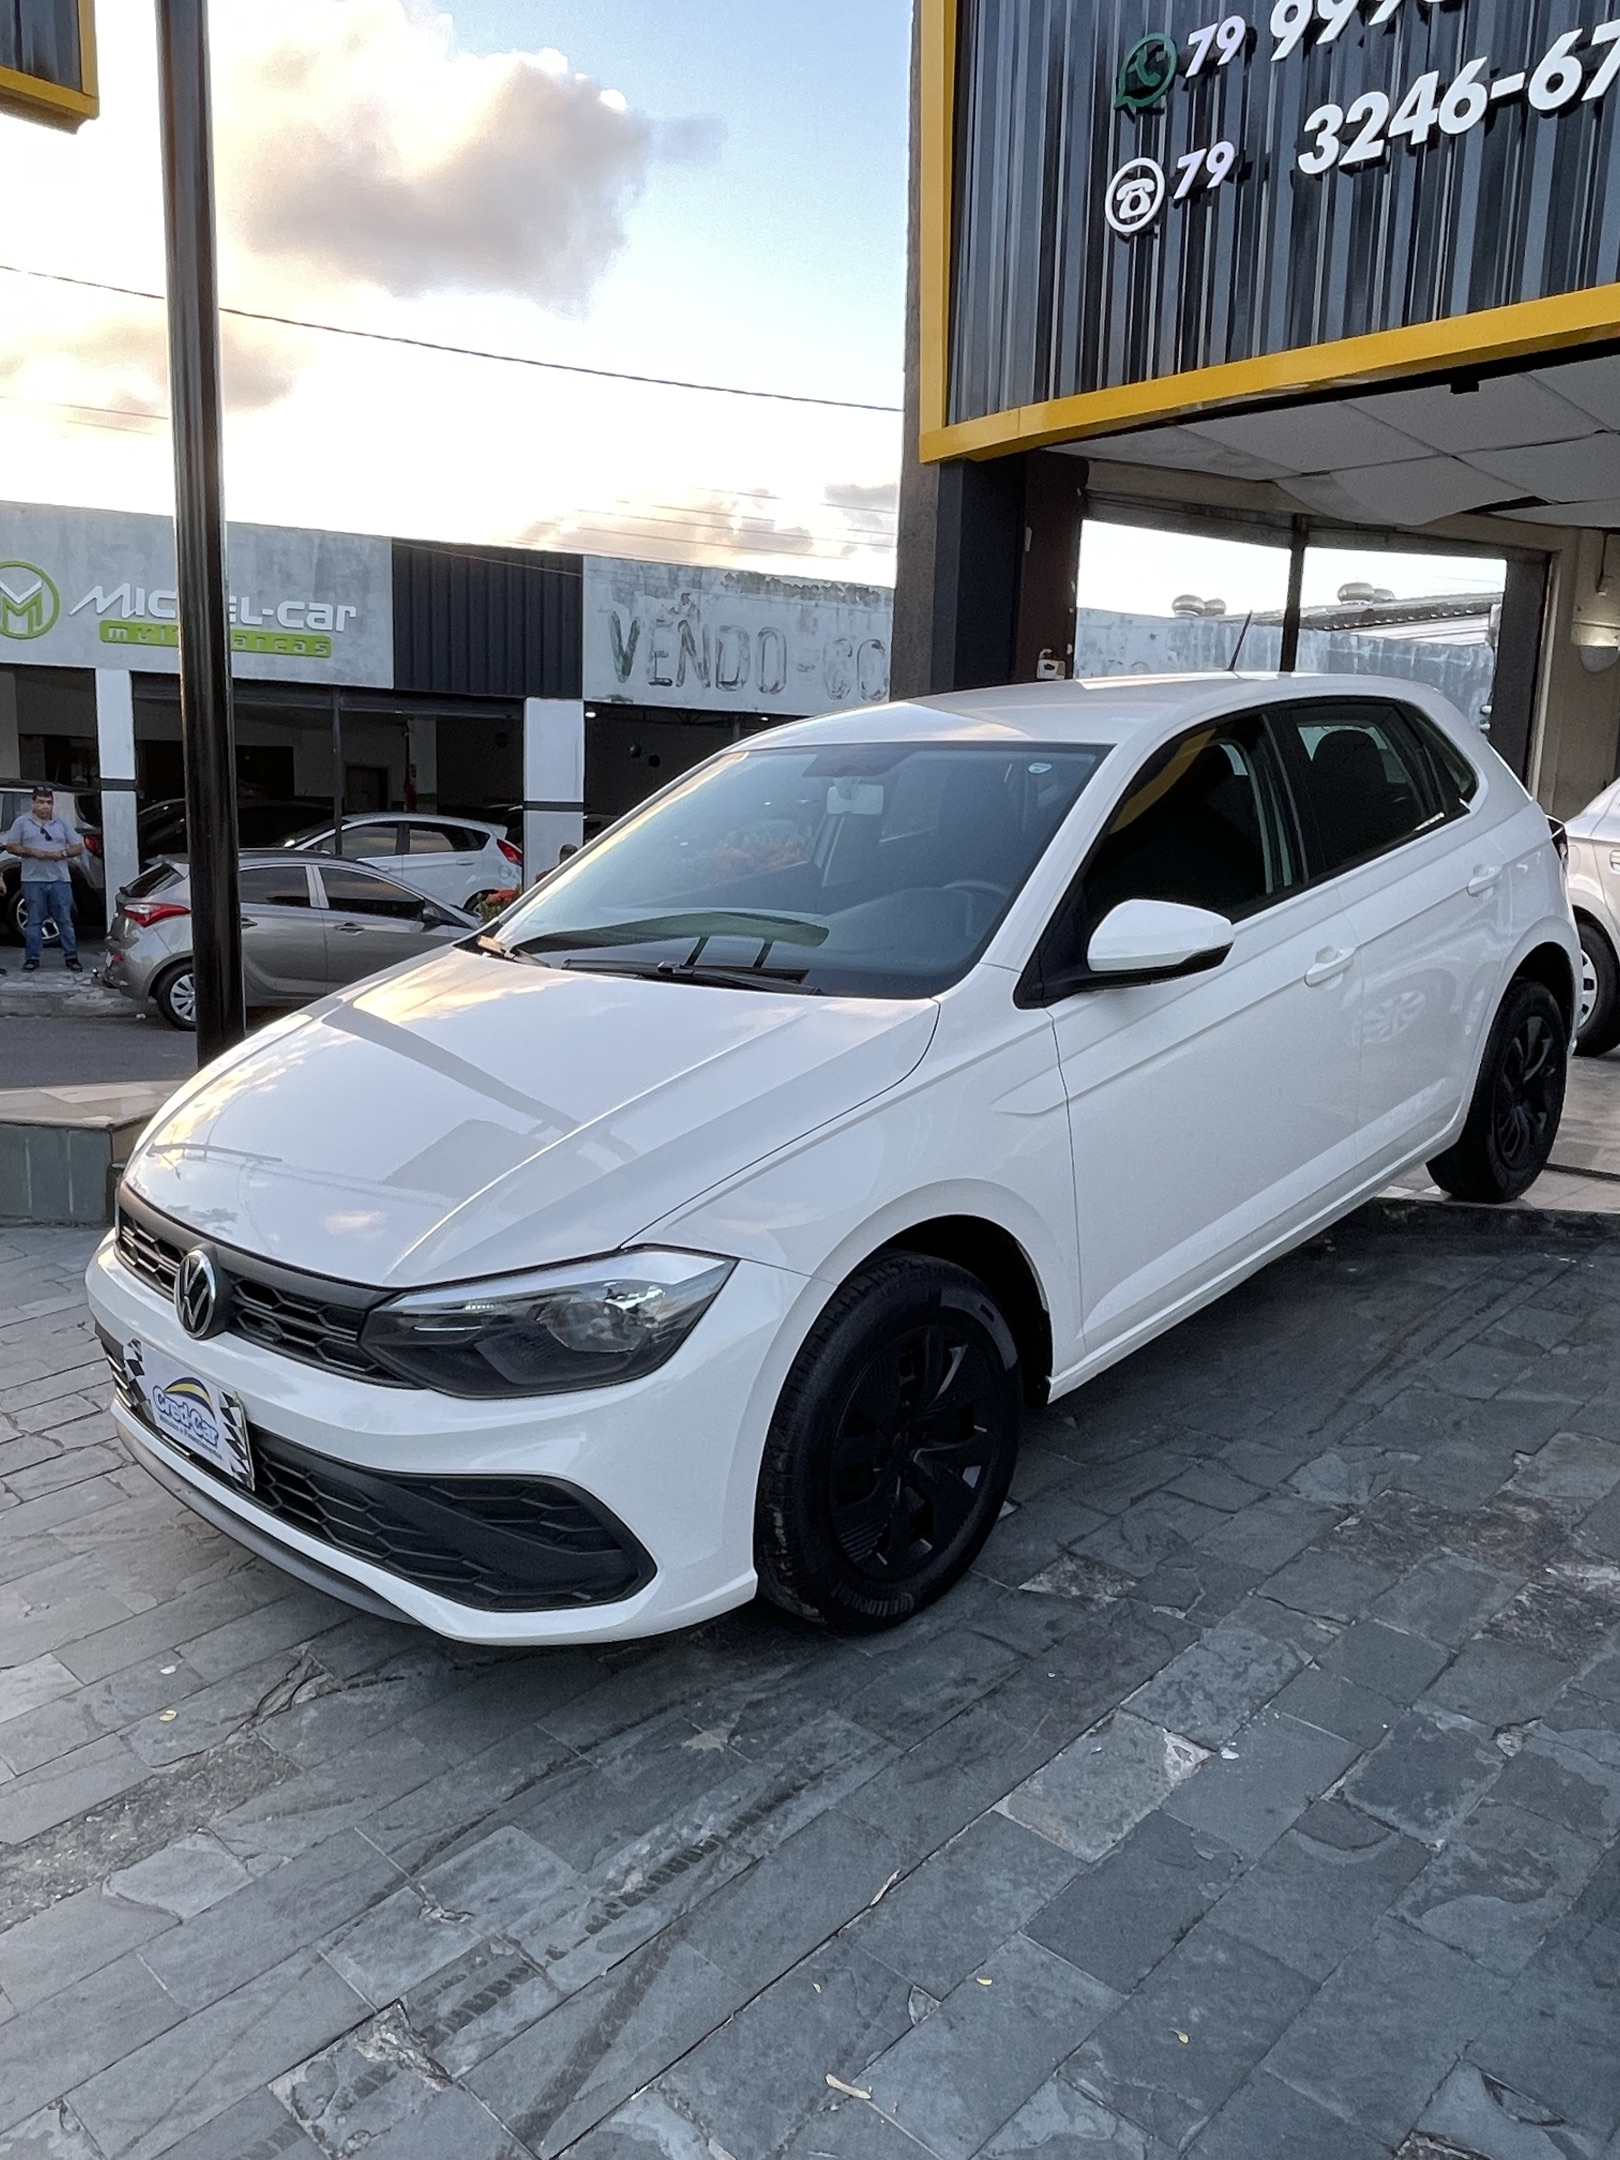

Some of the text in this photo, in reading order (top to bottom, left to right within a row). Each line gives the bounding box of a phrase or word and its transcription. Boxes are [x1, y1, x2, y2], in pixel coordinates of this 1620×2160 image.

[1184, 15, 1246, 79] 79
[1173, 18, 1620, 200] 79 3246-67
